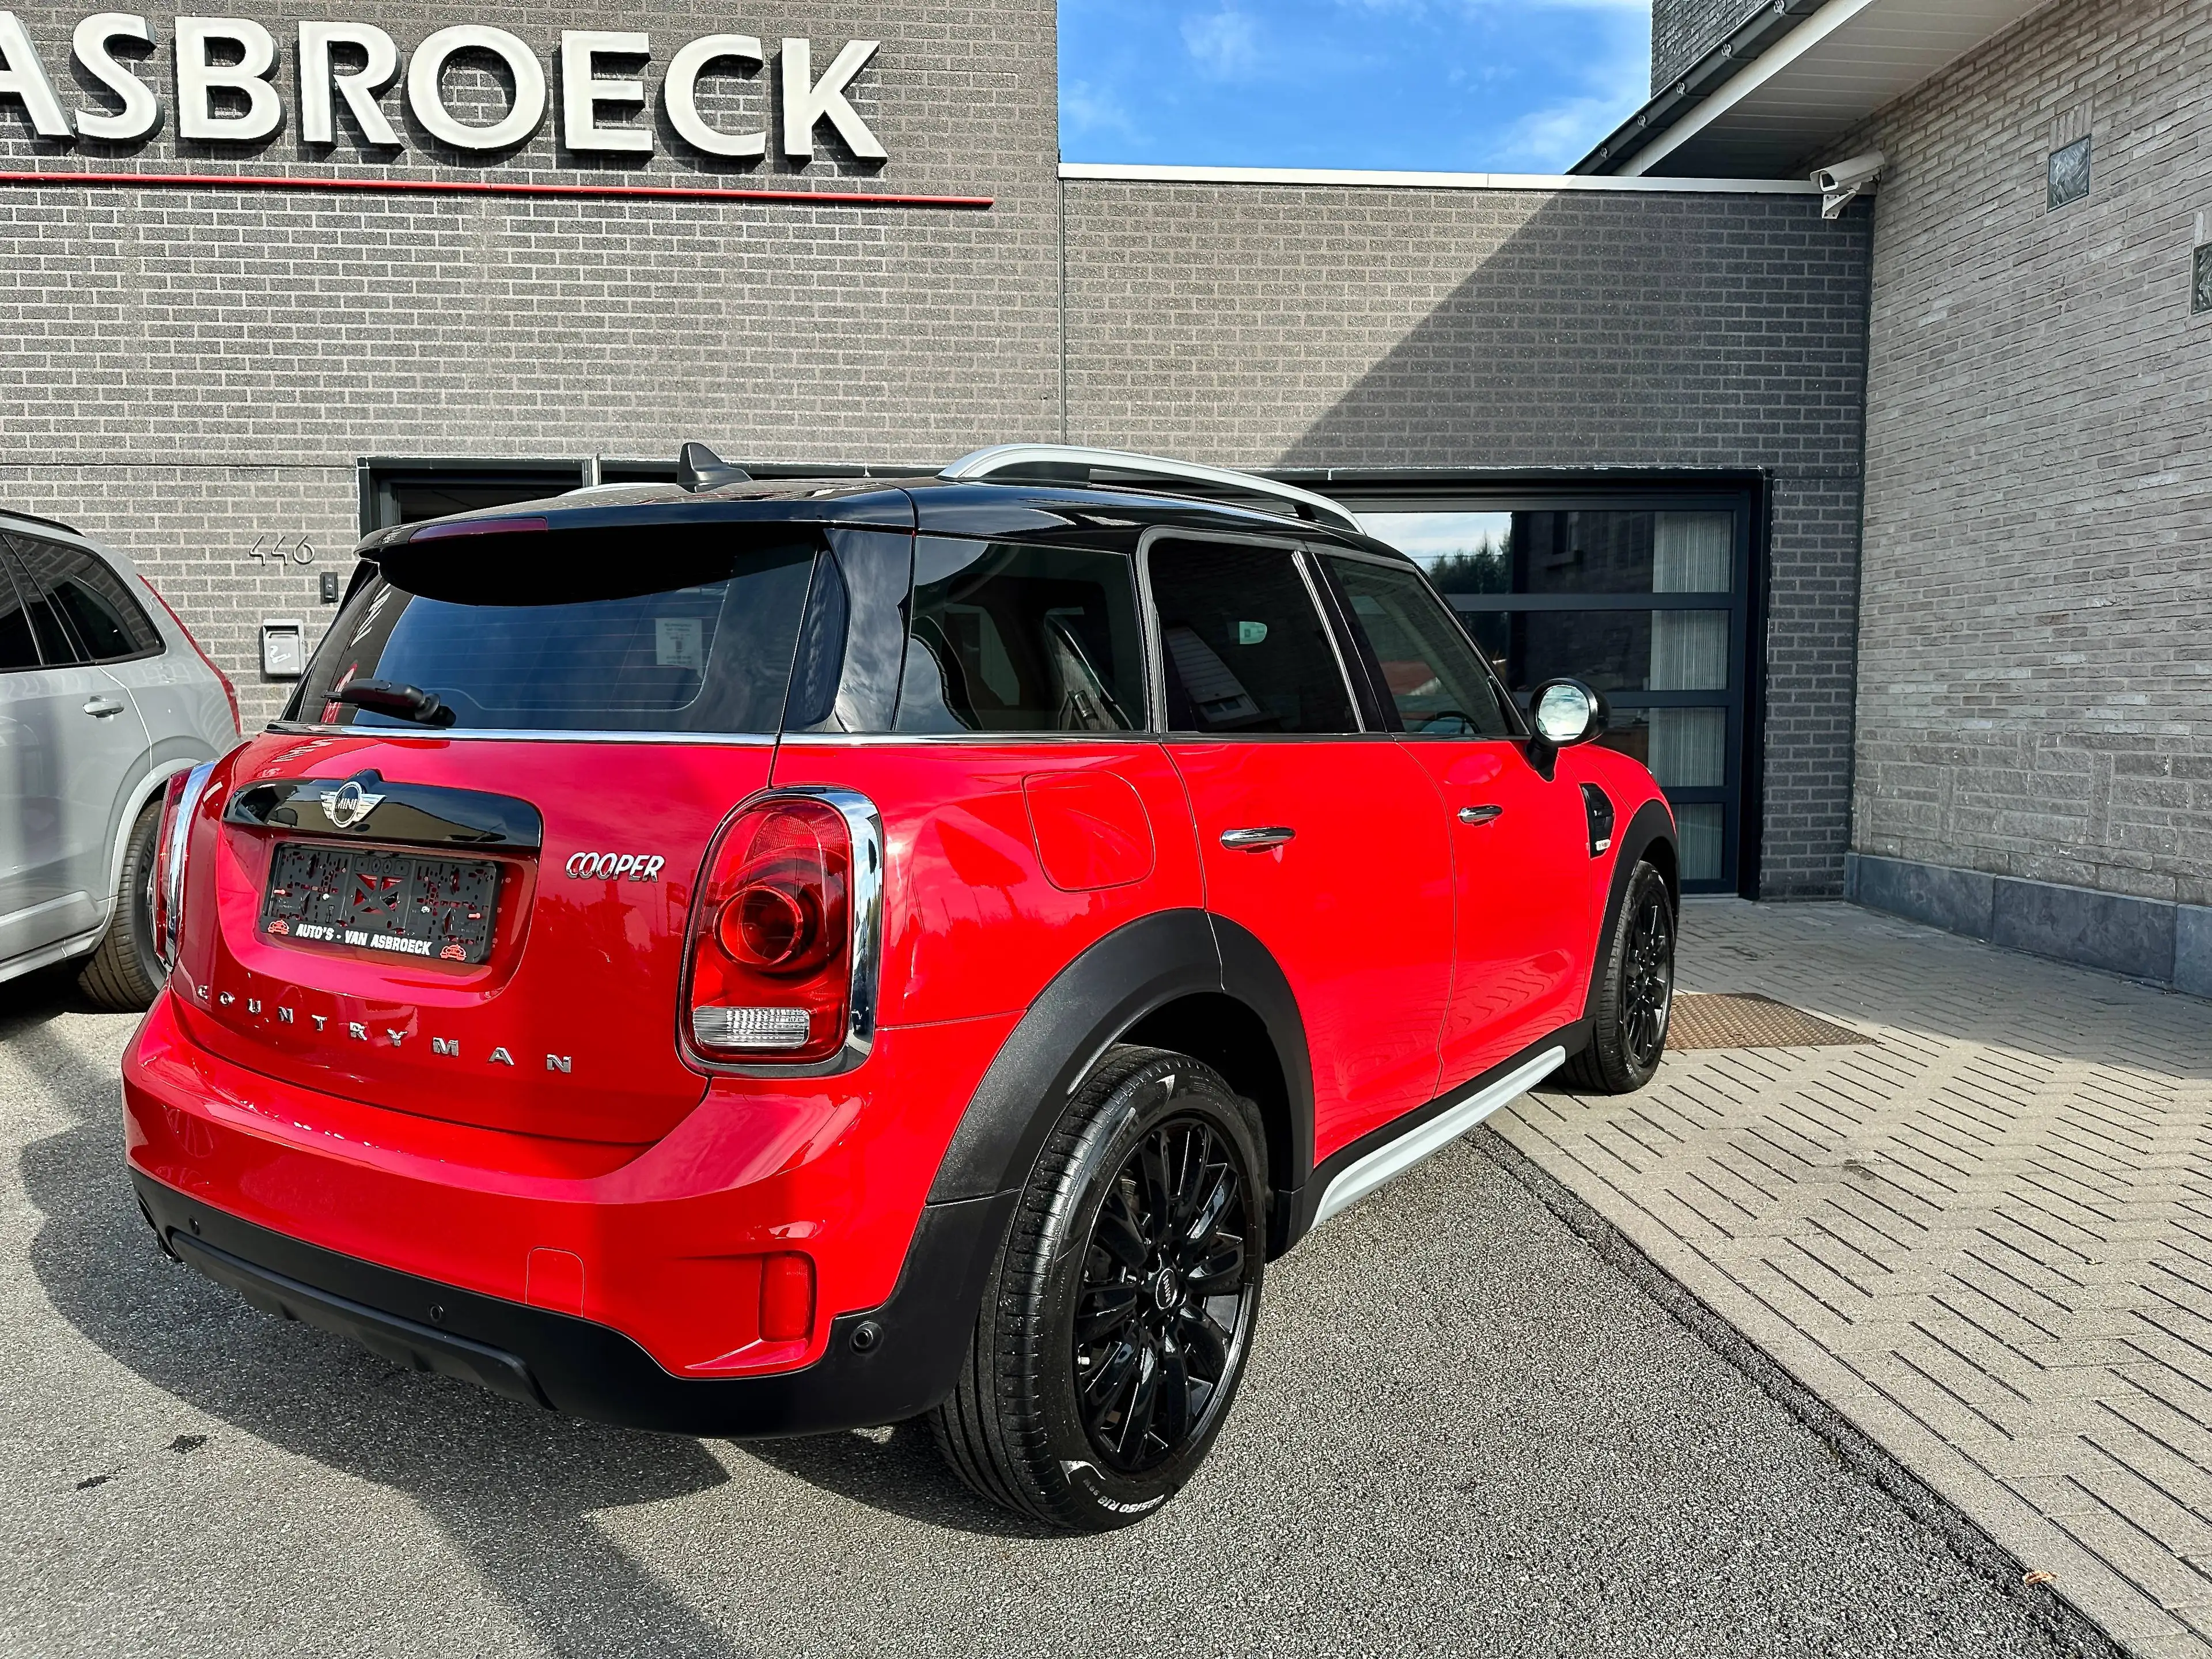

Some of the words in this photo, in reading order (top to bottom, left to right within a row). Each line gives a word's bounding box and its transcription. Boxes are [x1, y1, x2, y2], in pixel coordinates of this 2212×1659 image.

[249, 535, 315, 566] 446
[336, 798, 358, 810] MINI
[566, 851, 665, 882] COOPER
[296, 923, 334, 941] AUTO'S
[345, 930, 368, 946] VAN
[370, 934, 432, 956] ASBROECK
[197, 984, 572, 1073] COUNTRYMAN
[1162, 1275, 1171, 1303] MINI
